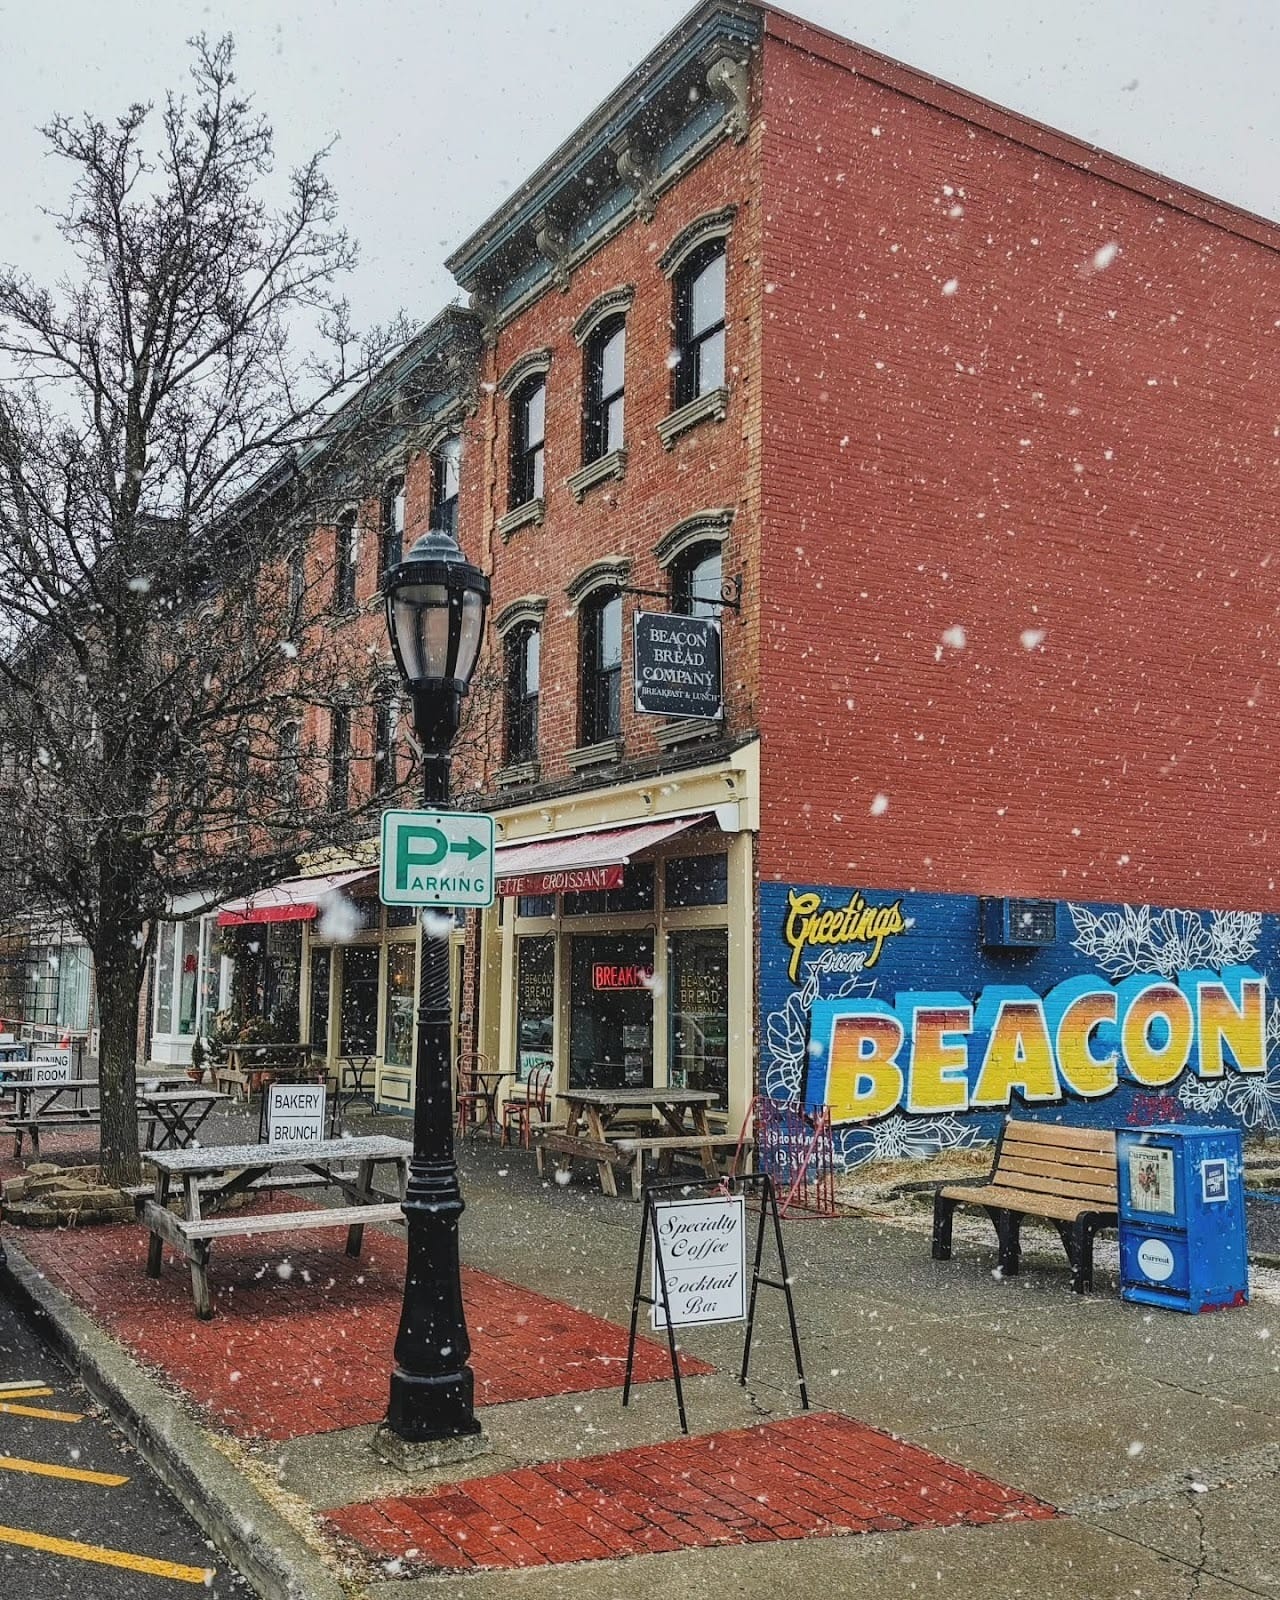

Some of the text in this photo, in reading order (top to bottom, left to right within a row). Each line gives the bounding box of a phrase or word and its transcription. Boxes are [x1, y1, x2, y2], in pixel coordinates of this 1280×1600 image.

[650, 629, 707, 647] BEACON
[654, 649, 705, 666] BREAD
[643, 667, 714, 686] COMPANY
[642, 687, 682, 698] BREAKFAST
[396, 825, 485, 892] PARKING
[542, 868, 609, 890] CROISSANT
[786, 888, 905, 982] Greetings
[681, 989, 719, 1003] BREAD
[824, 977, 1268, 1125] BEACON
[37, 1070, 66, 1081] ROOM
[275, 1094, 320, 1109] BAKERY
[275, 1126, 318, 1140] BRUNCH
[659, 1214, 737, 1240] Specialty
[671, 1237, 729, 1262] Coffee
[1141, 1253, 1170, 1264] Current
[661, 1271, 738, 1296] Cocktail
[682, 1296, 717, 1315] Bar
